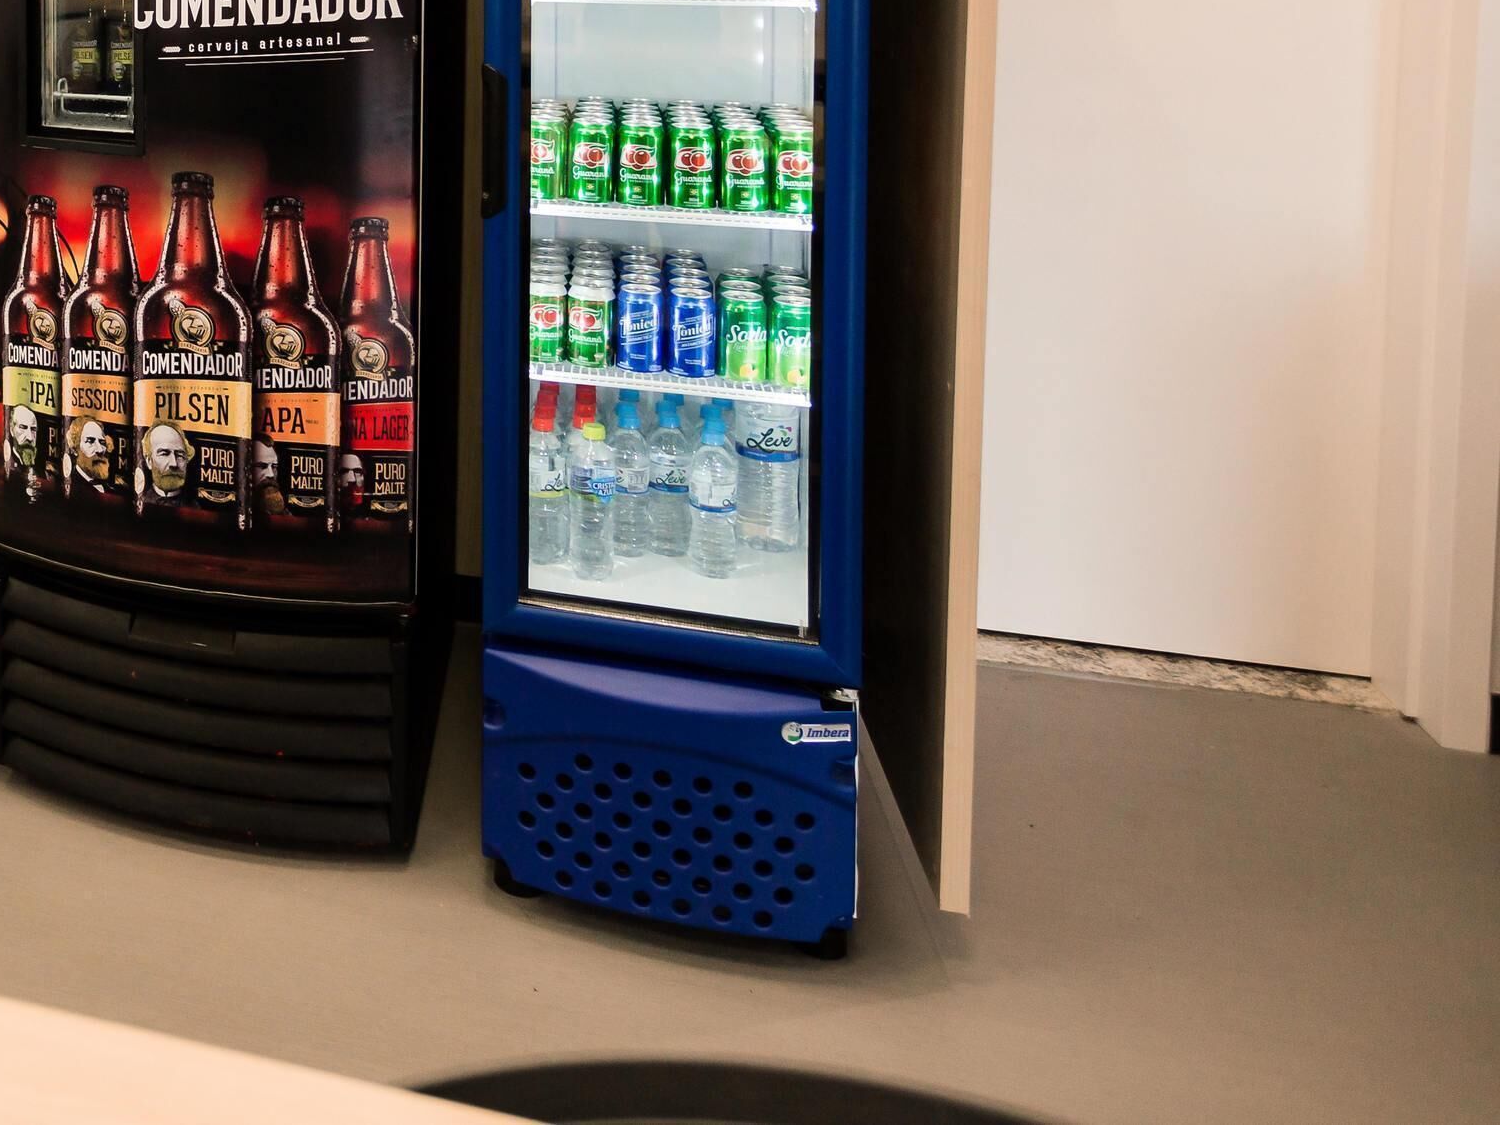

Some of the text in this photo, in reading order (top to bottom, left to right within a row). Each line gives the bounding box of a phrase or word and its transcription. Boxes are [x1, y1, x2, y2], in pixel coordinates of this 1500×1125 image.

[188, 32, 342, 55] cerveja artesanal
[774, 329, 811, 348] Sod
[142, 350, 243, 377] COMENDADOR
[29, 380, 56, 408] IPA
[71, 387, 128, 415] SESSION
[155, 392, 230, 426] PILSEN
[262, 407, 306, 435] APA
[373, 414, 409, 441] LAGER
[746, 428, 793, 453] Leve
[200, 447, 235, 468] PURO
[291, 455, 324, 475] PURO
[200, 467, 234, 485] MALTE
[375, 463, 406, 481] PURO
[655, 471, 686, 486] Leve
[290, 475, 323, 491] MALTE
[374, 481, 405, 495] MALTE
[806, 727, 849, 738] Imbera
